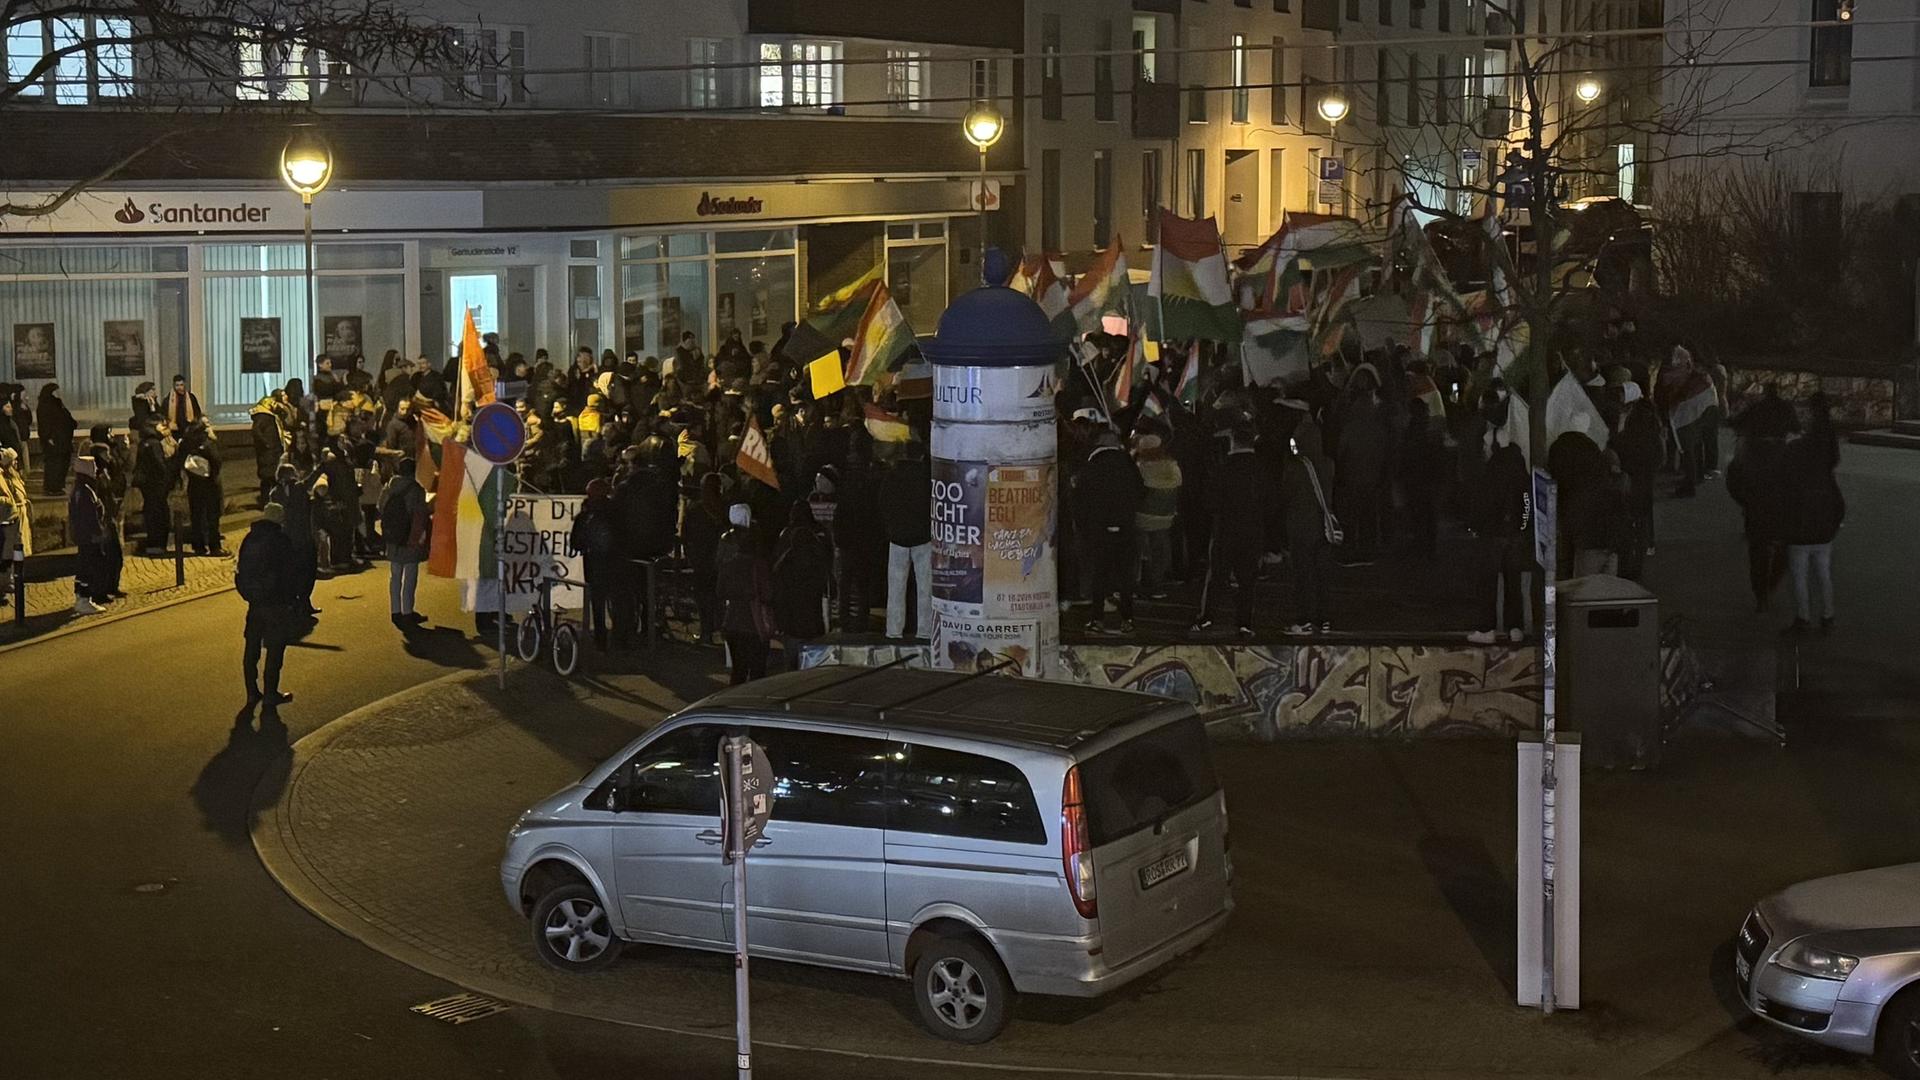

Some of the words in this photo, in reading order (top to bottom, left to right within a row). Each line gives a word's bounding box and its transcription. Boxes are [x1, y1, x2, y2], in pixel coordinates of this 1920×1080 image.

[1324, 161, 1338, 177] P
[149, 203, 271, 223] Santander
[934, 385, 982, 404] ULTUR
[931, 479, 963, 502] ZOO
[504, 499, 538, 520] PPT
[989, 506, 1016, 522] EGLI
[931, 520, 981, 545] AUBER
[942, 620, 972, 631] DAVID
[977, 624, 1033, 633] GARRETT
